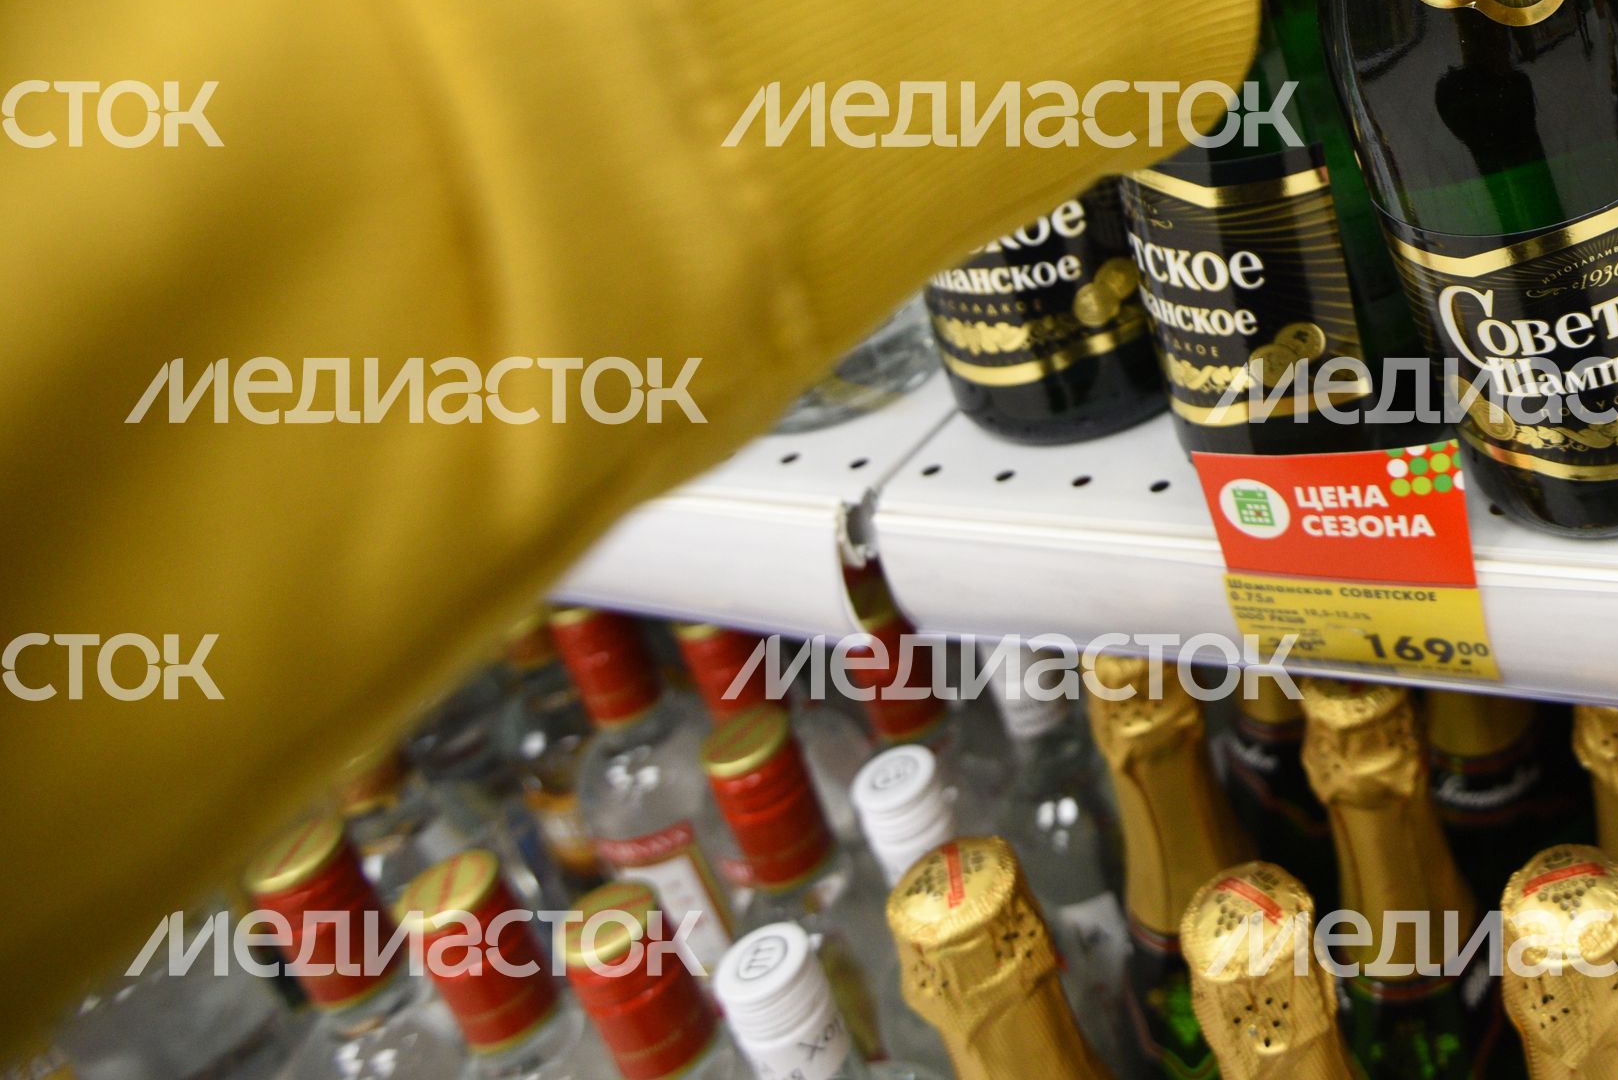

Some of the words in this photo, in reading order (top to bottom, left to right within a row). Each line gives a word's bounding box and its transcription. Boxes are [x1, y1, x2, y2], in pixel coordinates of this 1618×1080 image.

[1128, 231, 1265, 292] тское
[1293, 485, 1389, 512] ЦЕНА
[1301, 514, 1436, 538] СЕЗОНА
[1227, 579, 1333, 596] Шампанское
[1339, 587, 1437, 602] СОВЕТСКОЕ
